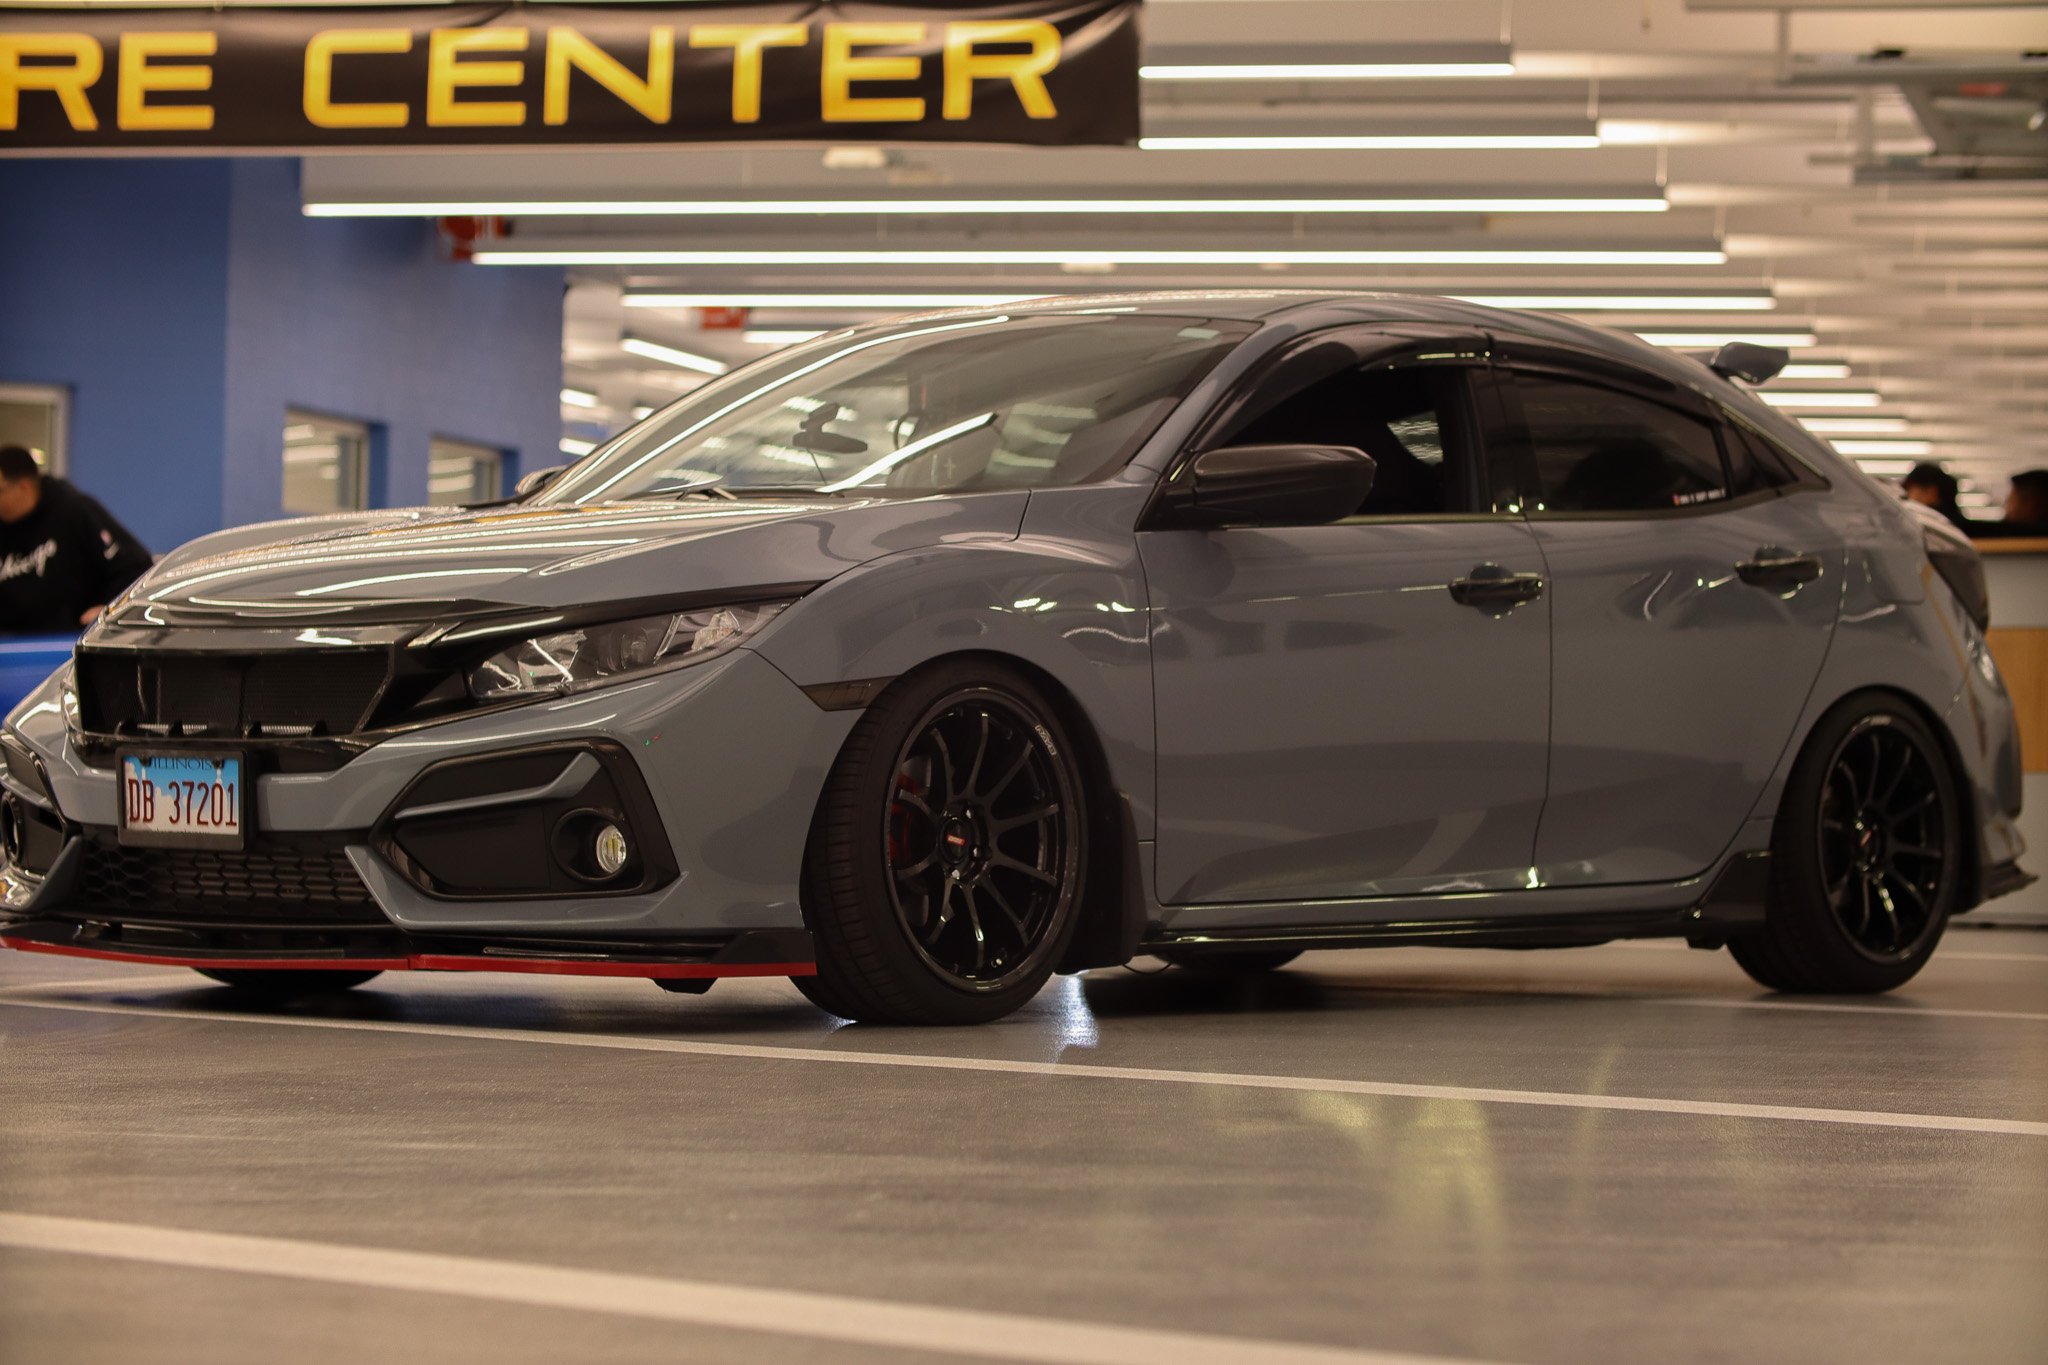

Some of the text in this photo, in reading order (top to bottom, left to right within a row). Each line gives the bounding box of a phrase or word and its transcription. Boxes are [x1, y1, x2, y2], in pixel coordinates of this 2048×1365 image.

[0, 19, 1063, 131] RE CENTER
[153, 757, 213, 771] ILLINOIS
[128, 778, 237, 827] DB 37201
